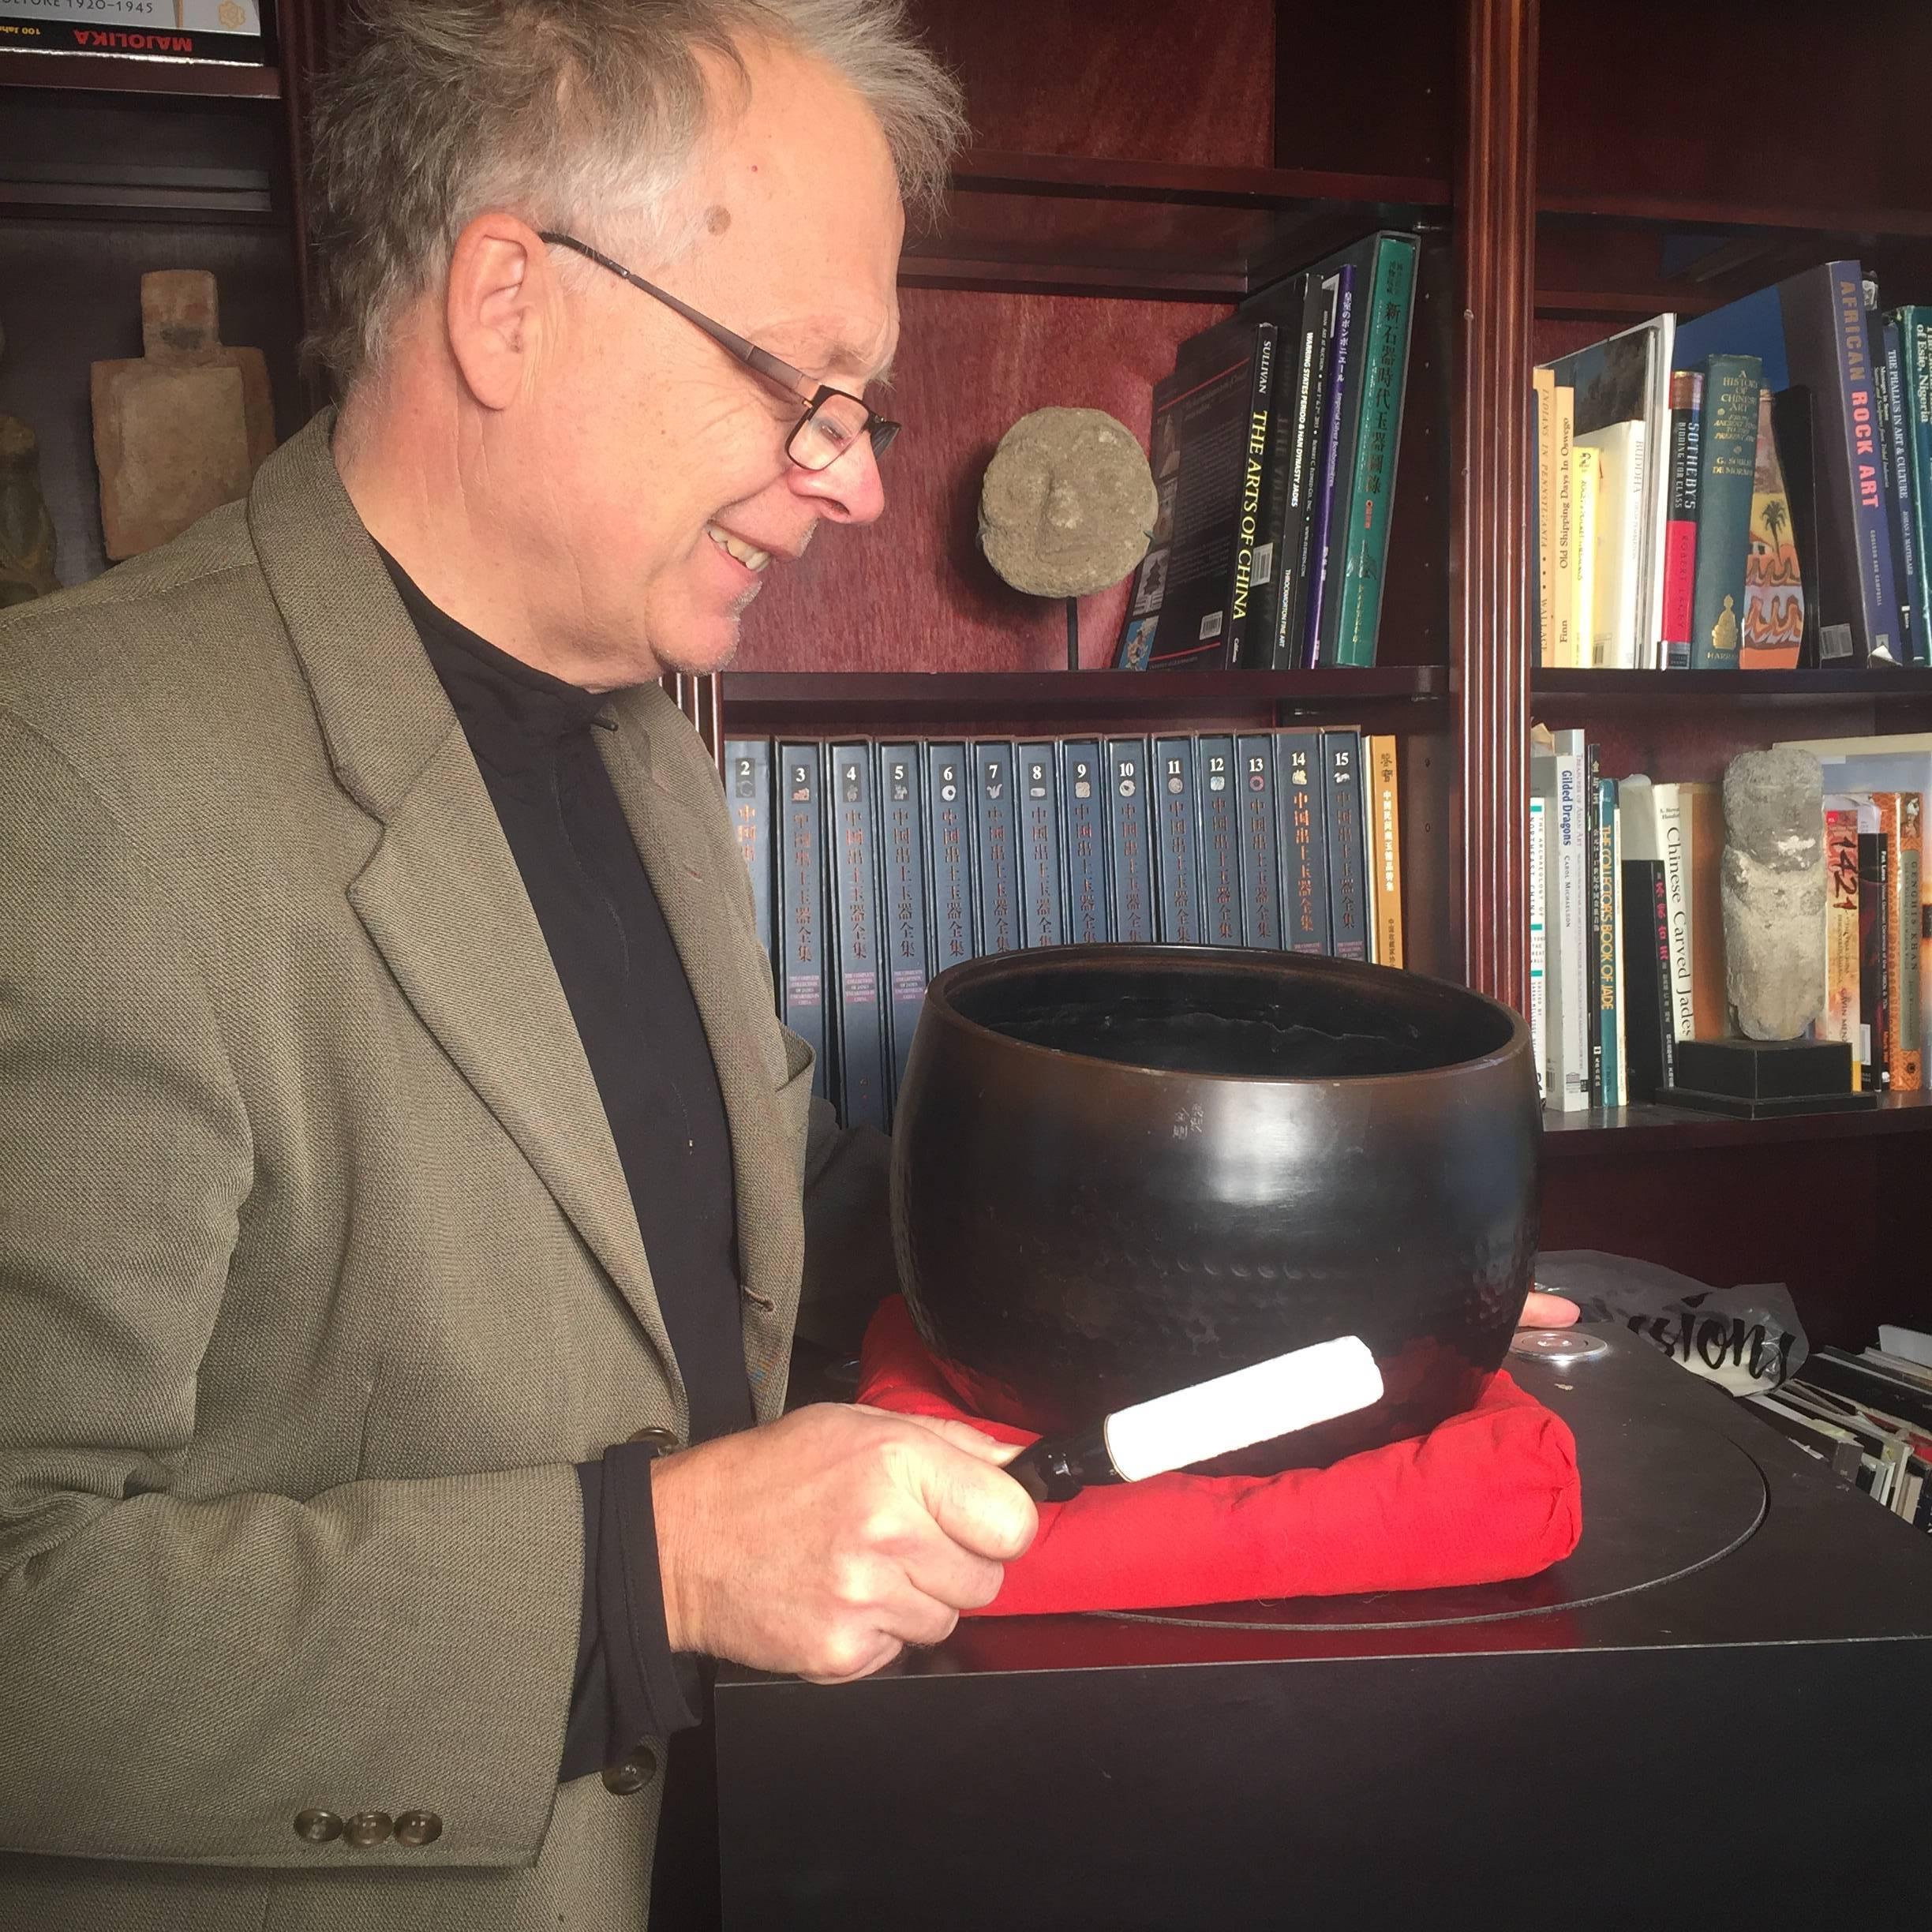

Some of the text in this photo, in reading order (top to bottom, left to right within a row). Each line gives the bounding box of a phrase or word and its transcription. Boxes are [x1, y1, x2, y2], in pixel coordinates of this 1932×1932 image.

[74, 30, 192, 52] MAJOLIKA
[1916, 324, 1926, 339] of
[1303, 332, 1313, 368] WARRING
[1259, 340, 1271, 394] SULLIVAN
[1300, 368, 1311, 394] STATES
[1840, 281, 1878, 509] AFRICAN ROCK ART
[1918, 374, 1929, 424] Nigeria
[1298, 395, 1308, 423] PERIOD
[1728, 403, 1748, 413] ART
[1332, 421, 1341, 441] Silver
[1560, 417, 1570, 457] Oswego
[1888, 350, 1908, 499] THE PHALLUS IN ART & CULTURE
[1295, 430, 1305, 447] HAN
[1541, 444, 1549, 455] IN
[1677, 421, 1687, 458] BIDDING
[1293, 448, 1302, 483] DYNASTY
[1560, 460, 1568, 471] In
[1633, 440, 1644, 493] BUDDHA
[1684, 422, 1700, 510] SOTHEBY'S
[1290, 483, 1300, 507] JADES
[1560, 474, 1570, 499] Days
[1233, 410, 1267, 620] THE ARTS OF CHINA
[1559, 503, 1570, 547] Shipping
[1559, 549, 1568, 569] Old
[1280, 569, 1291, 620] THROCKMORTON
[1676, 535, 1688, 629] ROBERT LACEY
[740, 762, 751, 775] 2
[1077, 764, 1086, 778] 9
[1119, 763, 1134, 777] 10
[1167, 760, 1181, 774] 11
[1210, 758, 1224, 772] 12
[1249, 758, 1264, 772] 13
[1291, 752, 1306, 766] 14
[1335, 752, 1350, 766] 15
[796, 768, 806, 782] 3
[847, 766, 856, 781] 4
[894, 766, 904, 780] 5
[943, 766, 953, 781] 6
[989, 765, 998, 779] 7
[1032, 766, 1042, 780] 8
[1559, 769, 1574, 846] Gilded Dragons
[1667, 826, 1682, 903] Chinese
[1830, 836, 1859, 910] 1421
[1601, 826, 1614, 1010] THE COLLECTOR'S BOOK OF JADE
[1672, 911, 1691, 979] Carved
[1677, 988, 1694, 1036] Jades
[1840, 989, 1850, 1017] GAVIN
